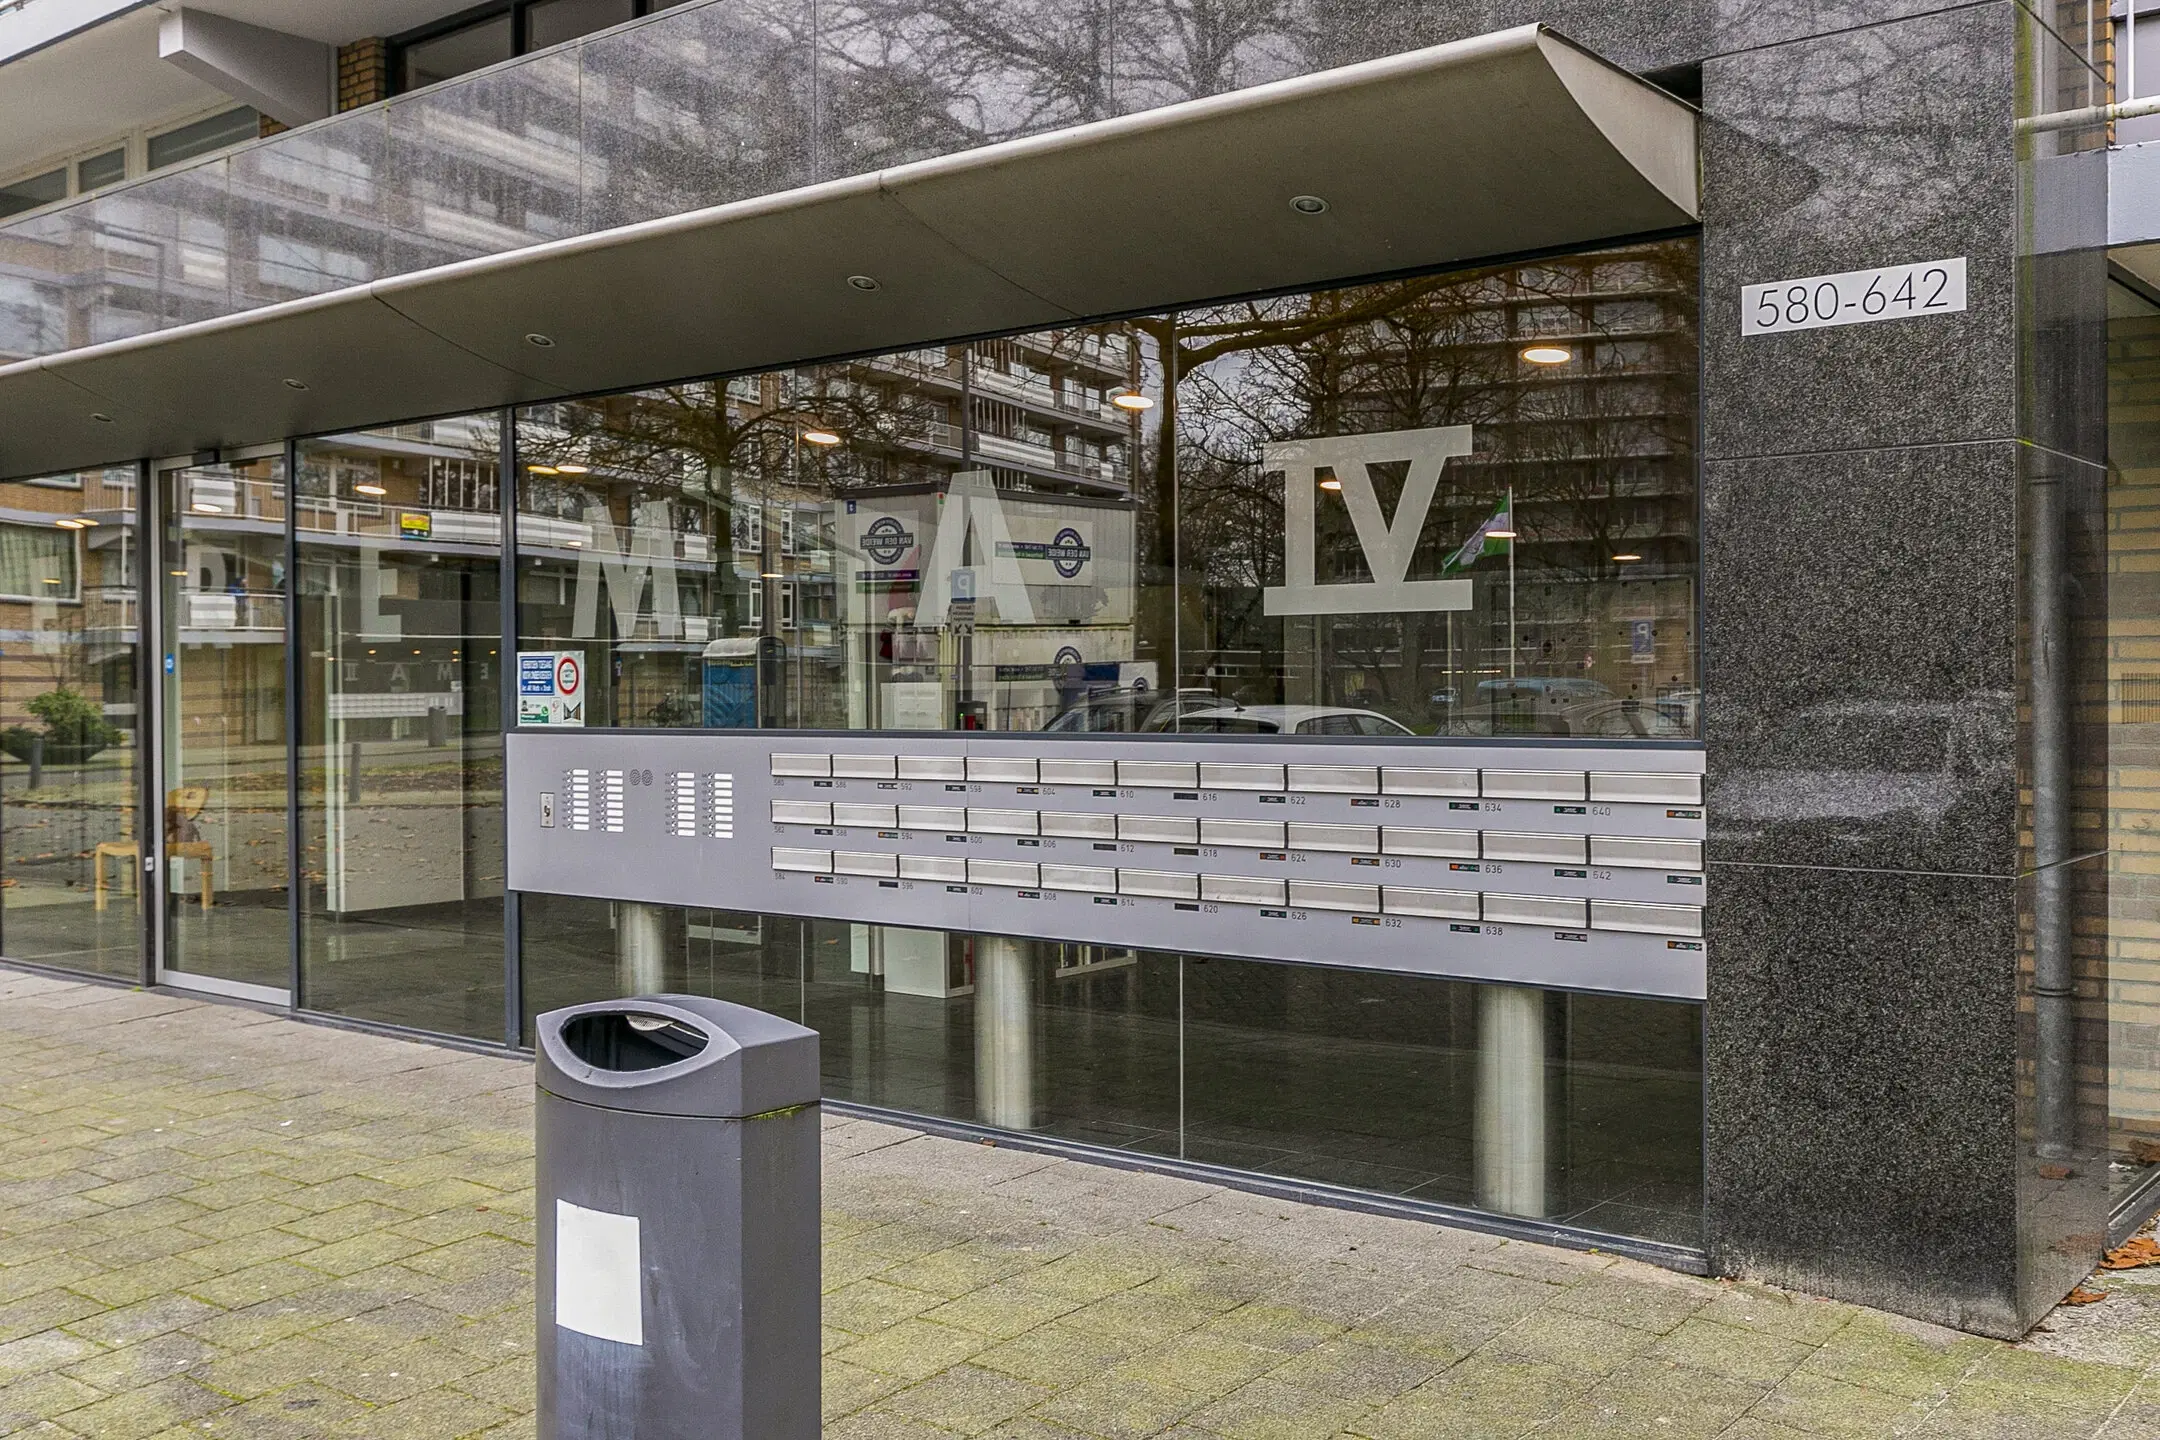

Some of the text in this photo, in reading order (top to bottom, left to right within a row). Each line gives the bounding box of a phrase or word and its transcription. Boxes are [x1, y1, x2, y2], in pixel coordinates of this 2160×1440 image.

[1756, 268, 1949, 327] 580-642
[1263, 424, 1473, 616] IV
[1042, 787, 1056, 796] 604
[1120, 790, 1134, 799] 610
[1202, 793, 1217, 801] 616
[1290, 796, 1306, 805] 622
[1384, 799, 1401, 809] 628
[1484, 802, 1502, 813] 634
[1592, 806, 1611, 817] 640
[1043, 840, 1056, 849] 606
[1121, 844, 1134, 852] 612
[1203, 848, 1217, 858] 618
[1291, 853, 1306, 863] 624
[1385, 859, 1402, 868] 630
[1485, 864, 1503, 874] 636
[1592, 870, 1612, 881] 642
[971, 887, 983, 896] 602
[1044, 892, 1056, 901] 608
[1121, 899, 1135, 907] 614
[1204, 904, 1218, 914] 620
[1291, 911, 1307, 921] 626
[1385, 918, 1402, 928] 632
[1486, 926, 1503, 936] 638
